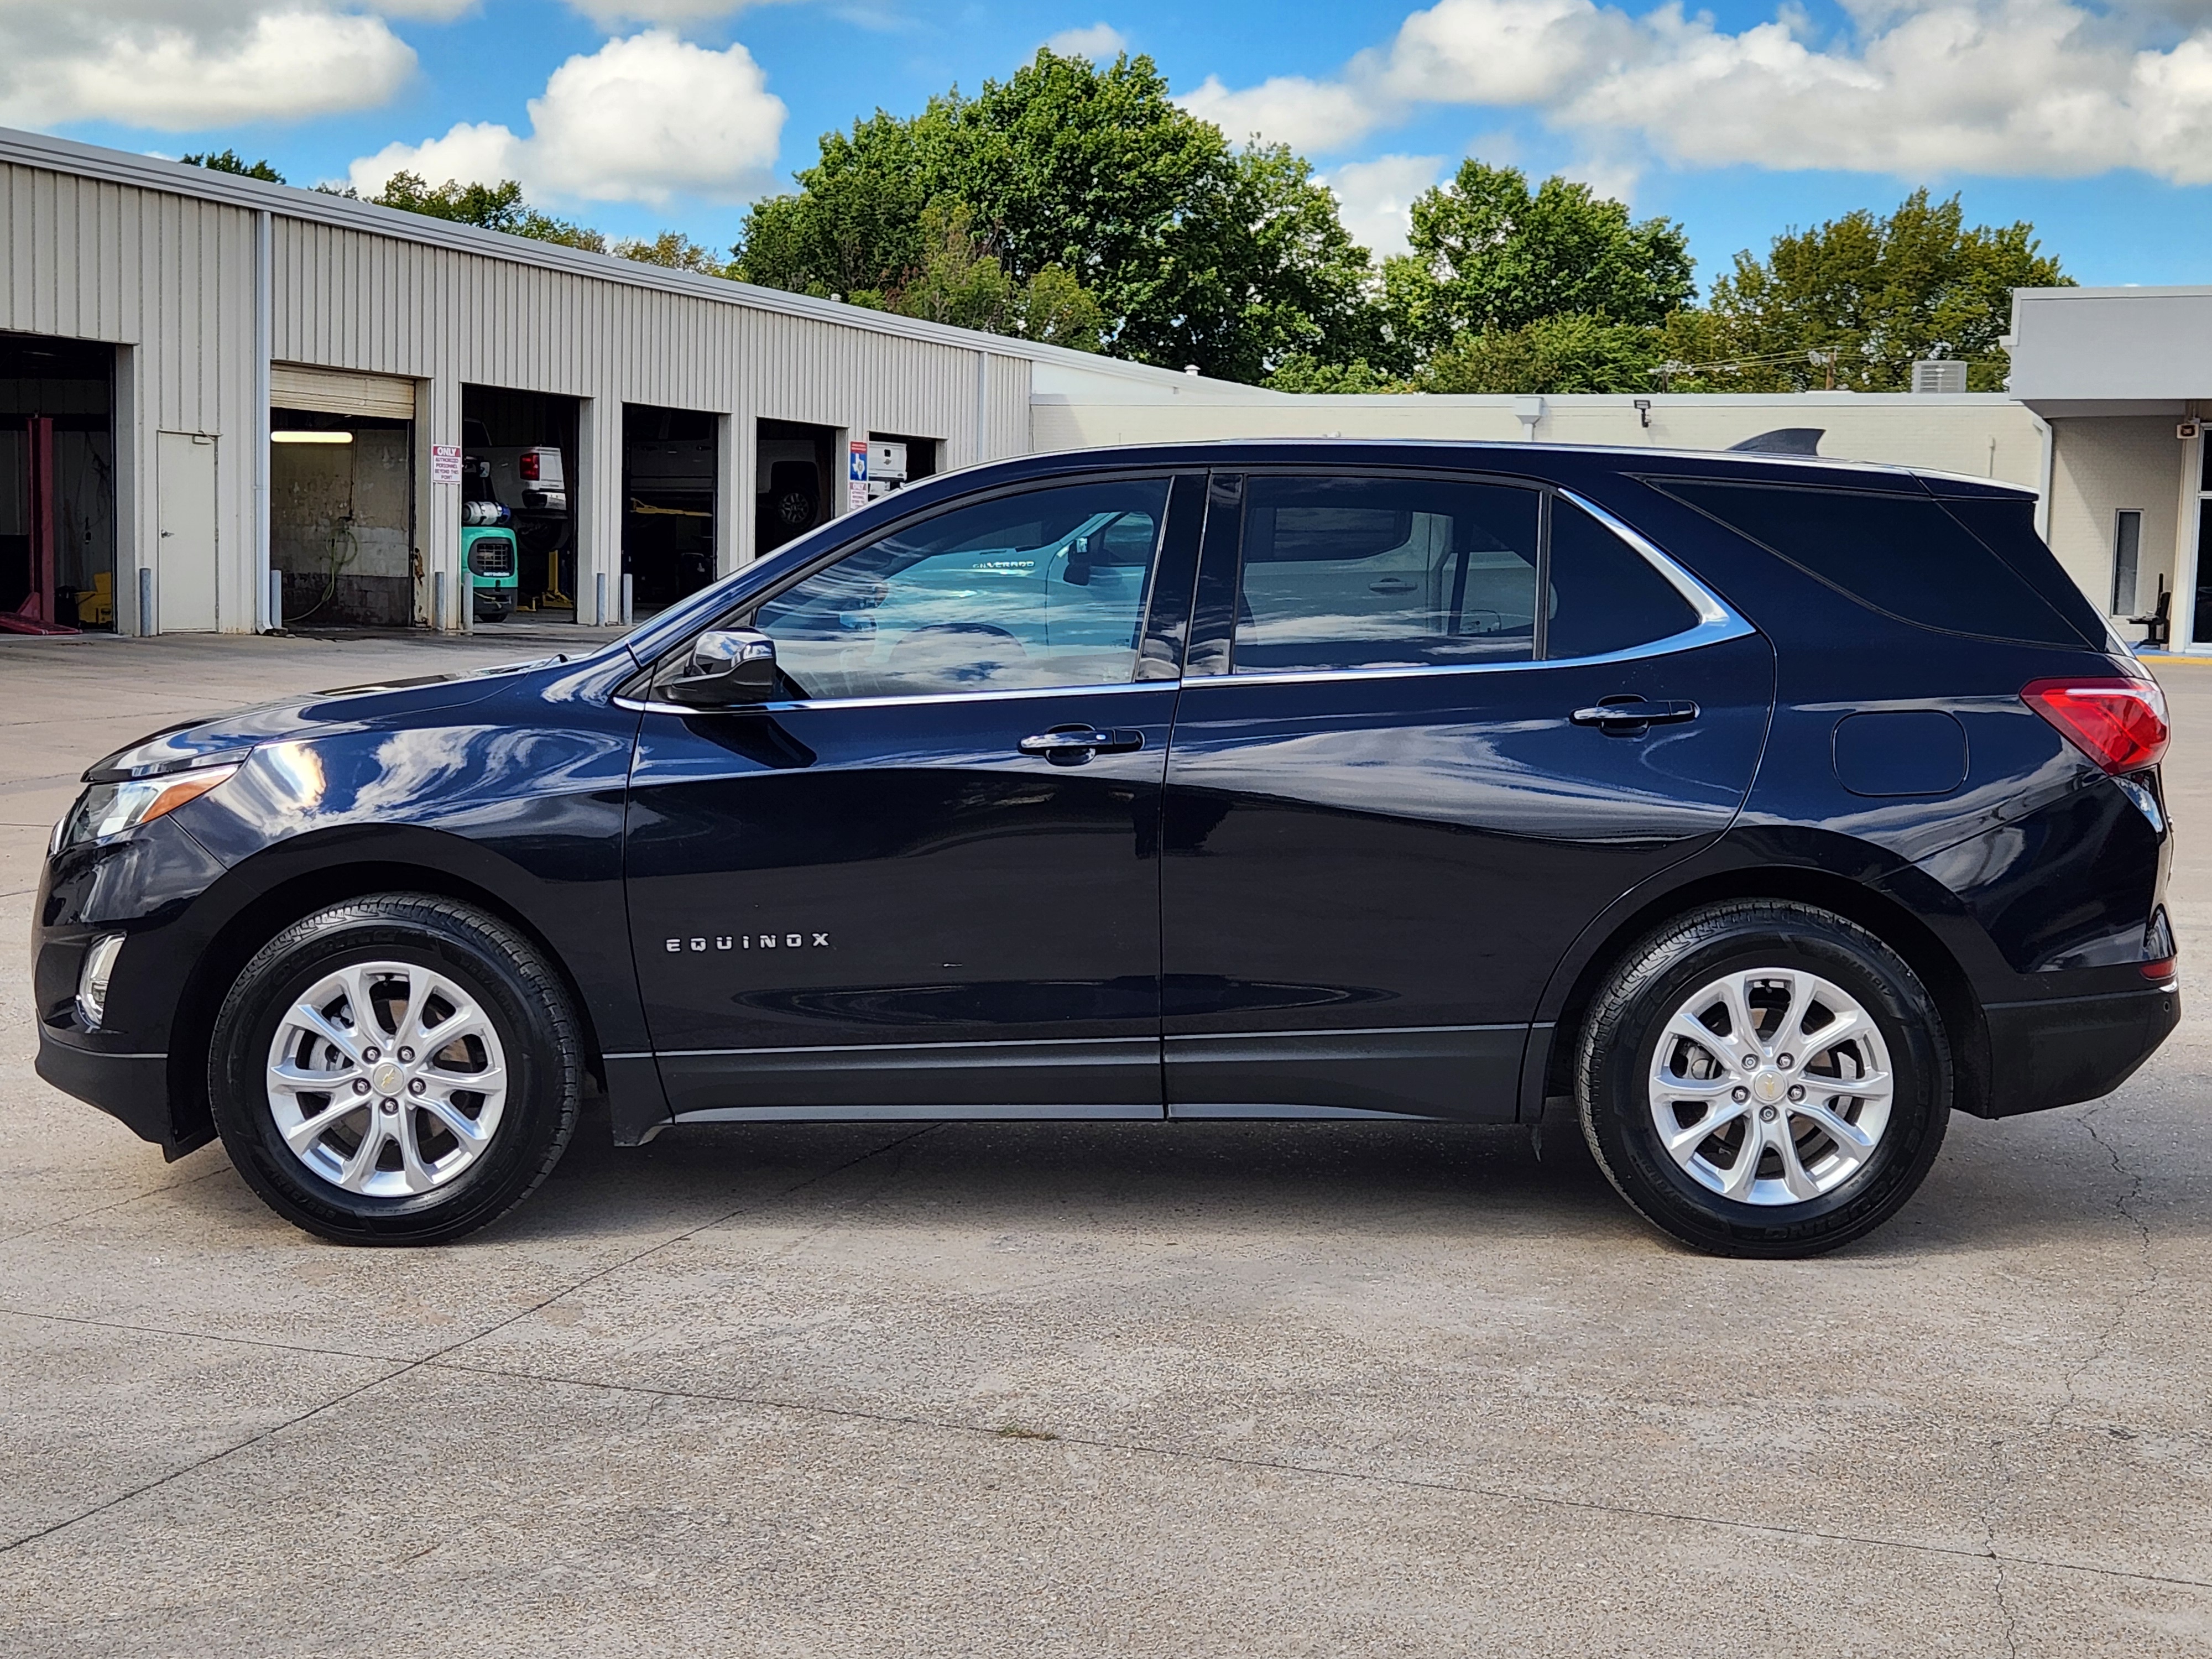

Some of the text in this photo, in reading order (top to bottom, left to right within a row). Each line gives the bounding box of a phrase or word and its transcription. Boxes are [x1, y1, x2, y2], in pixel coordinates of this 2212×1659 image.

[437, 447, 456, 456] ONLY
[972, 561, 1035, 569] SILVERADO
[666, 933, 830, 952] EQUINOX
